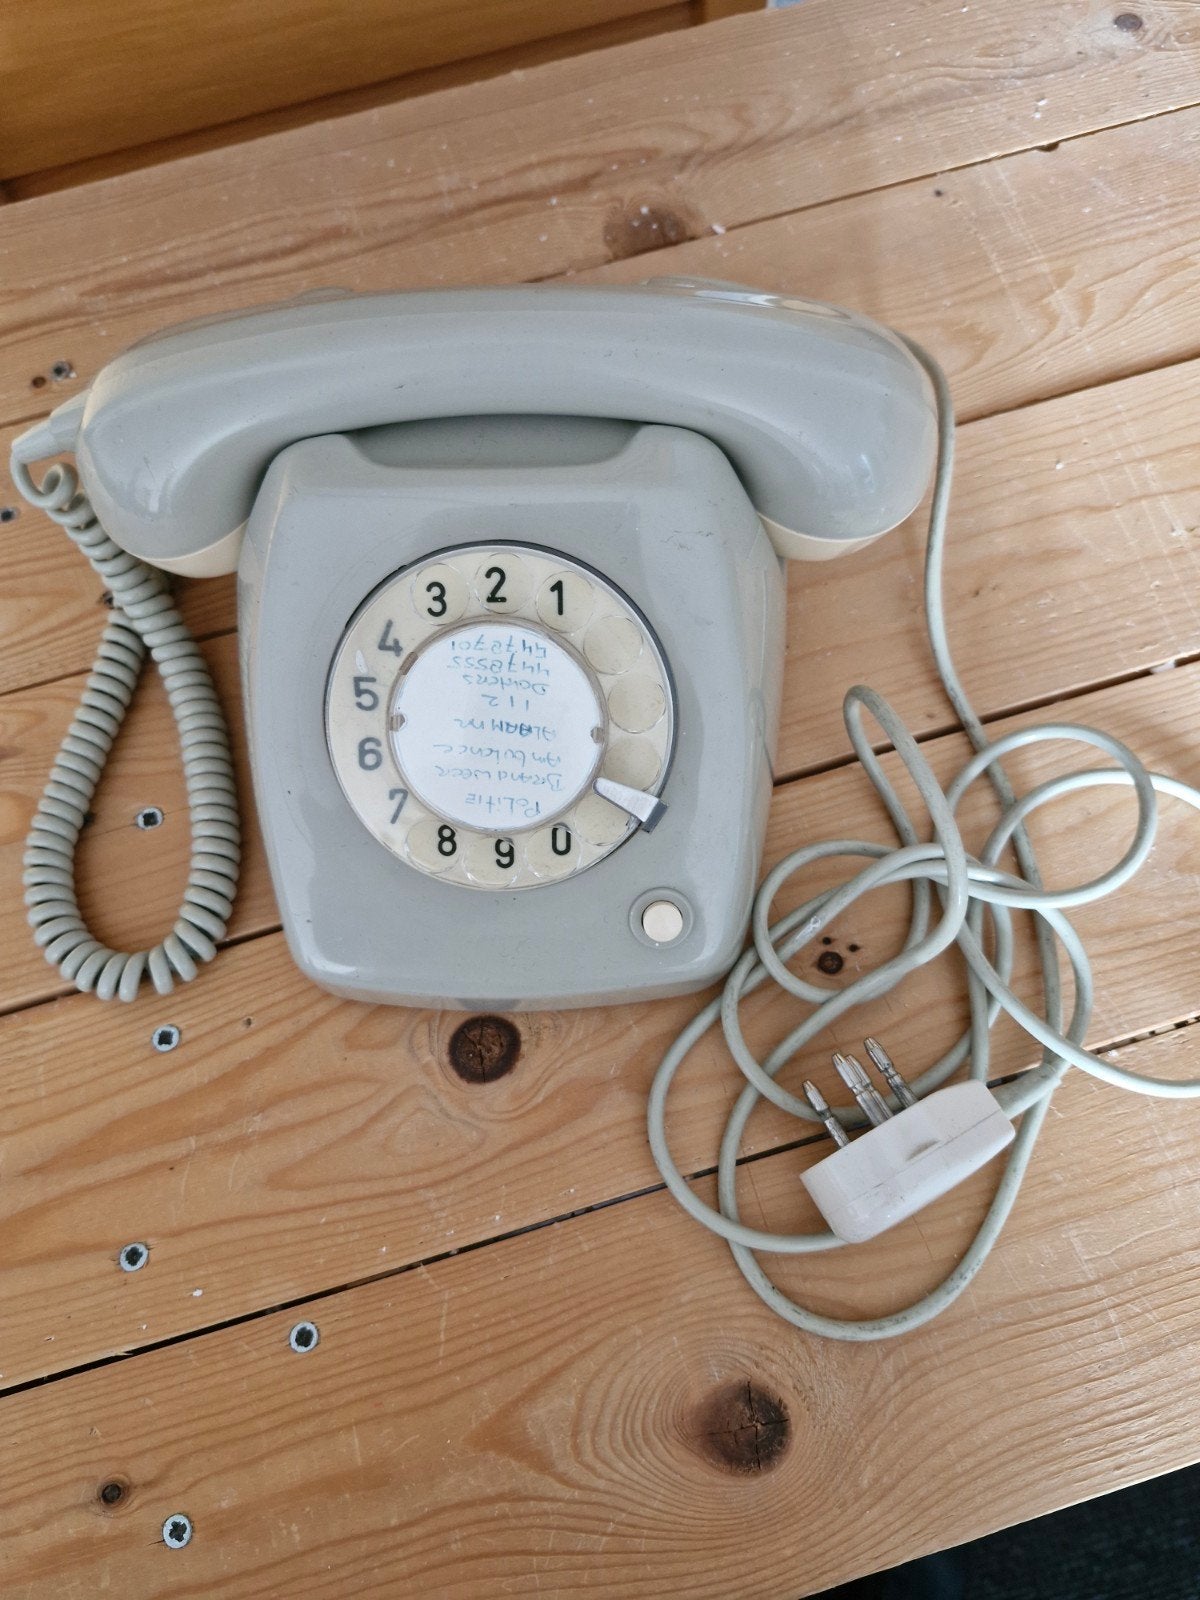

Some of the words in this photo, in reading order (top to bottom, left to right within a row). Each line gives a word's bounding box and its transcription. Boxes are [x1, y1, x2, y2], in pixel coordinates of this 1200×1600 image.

[425, 581, 447, 617] 3
[484, 566, 507, 603] 2
[549, 580, 564, 616] 1
[377, 619, 403, 656] 4
[353, 676, 379, 711] 5
[480, 694, 530, 712] 112
[357, 737, 383, 771] 6
[388, 787, 409, 825] 7
[437, 824, 458, 857] 8
[494, 837, 515, 869] 9
[551, 823, 572, 856] 0
